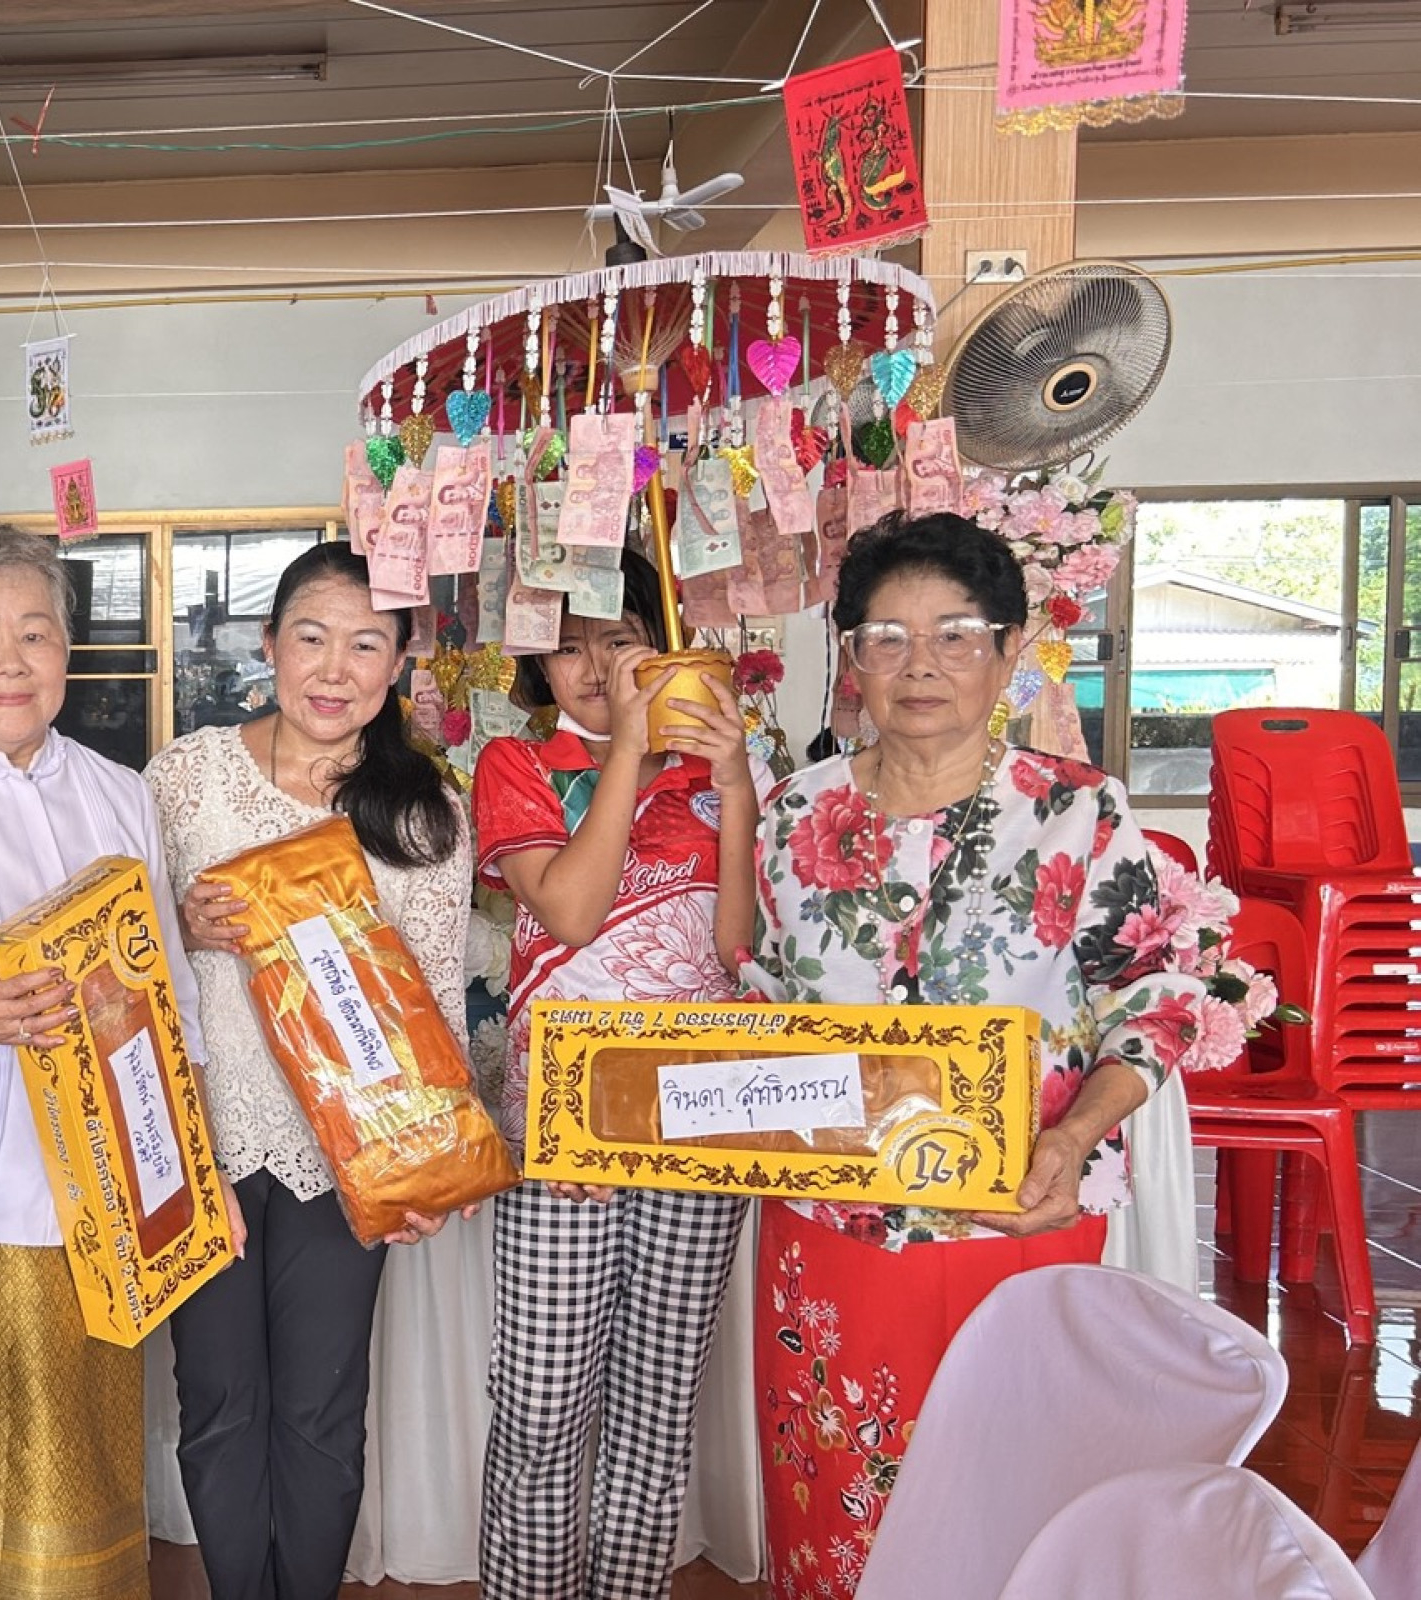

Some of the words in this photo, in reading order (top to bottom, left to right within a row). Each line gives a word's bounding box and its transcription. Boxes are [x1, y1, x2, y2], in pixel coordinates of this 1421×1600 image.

[635, 854, 697, 893] School
[547, 1009, 593, 1024] เมตร
[598, 1011, 611, 1026] 2
[653, 1011, 663, 1026] 7
[663, 1079, 724, 1110] จินดา
[111, 1218, 121, 1228] 7
[121, 1264, 131, 1278] 2
[125, 1281, 142, 1320] เมตร
